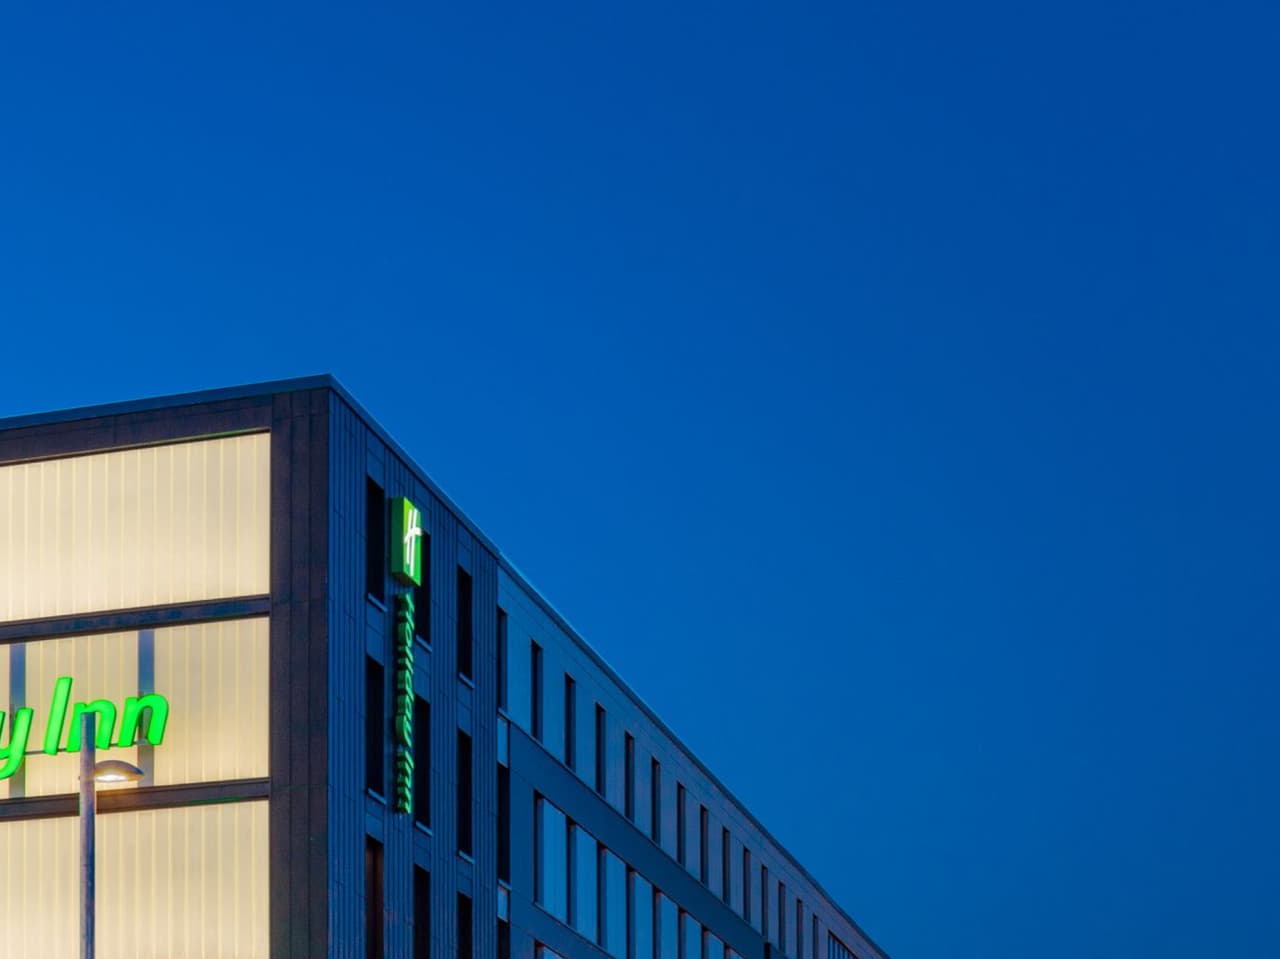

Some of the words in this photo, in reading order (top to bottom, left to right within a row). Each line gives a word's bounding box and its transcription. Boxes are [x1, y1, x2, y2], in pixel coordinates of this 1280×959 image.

[397, 592, 416, 748] Holiday
[45, 677, 169, 755] Inn
[397, 750, 415, 814] Inn
